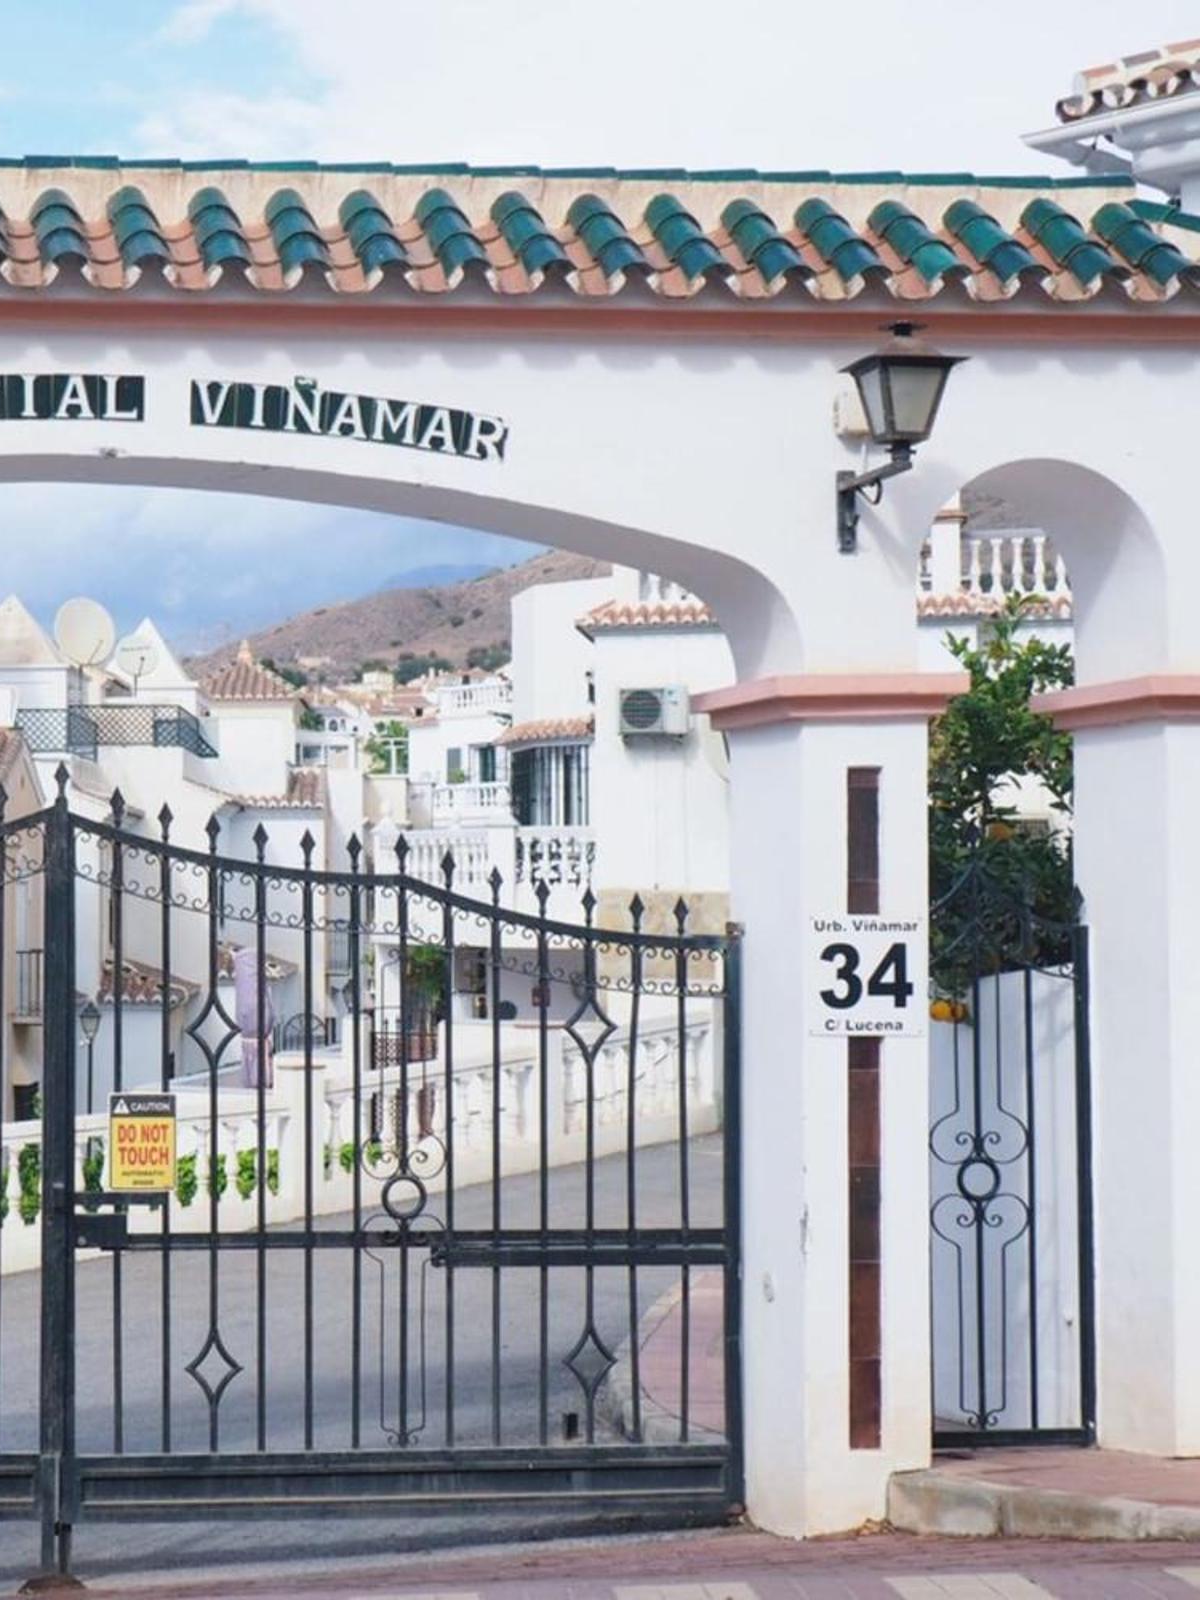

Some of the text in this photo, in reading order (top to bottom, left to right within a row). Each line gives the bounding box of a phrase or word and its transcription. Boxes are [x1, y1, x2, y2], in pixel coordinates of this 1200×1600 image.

[194, 376, 506, 463] VIÑAMAR
[814, 919, 918, 933] Urb. Viñamar
[819, 942, 914, 1010] 34
[845, 1019, 904, 1032] Lucena
[130, 1101, 171, 1113] CAUTION
[117, 1123, 170, 1144] DO NOT
[117, 1146, 170, 1166] TOUCH
